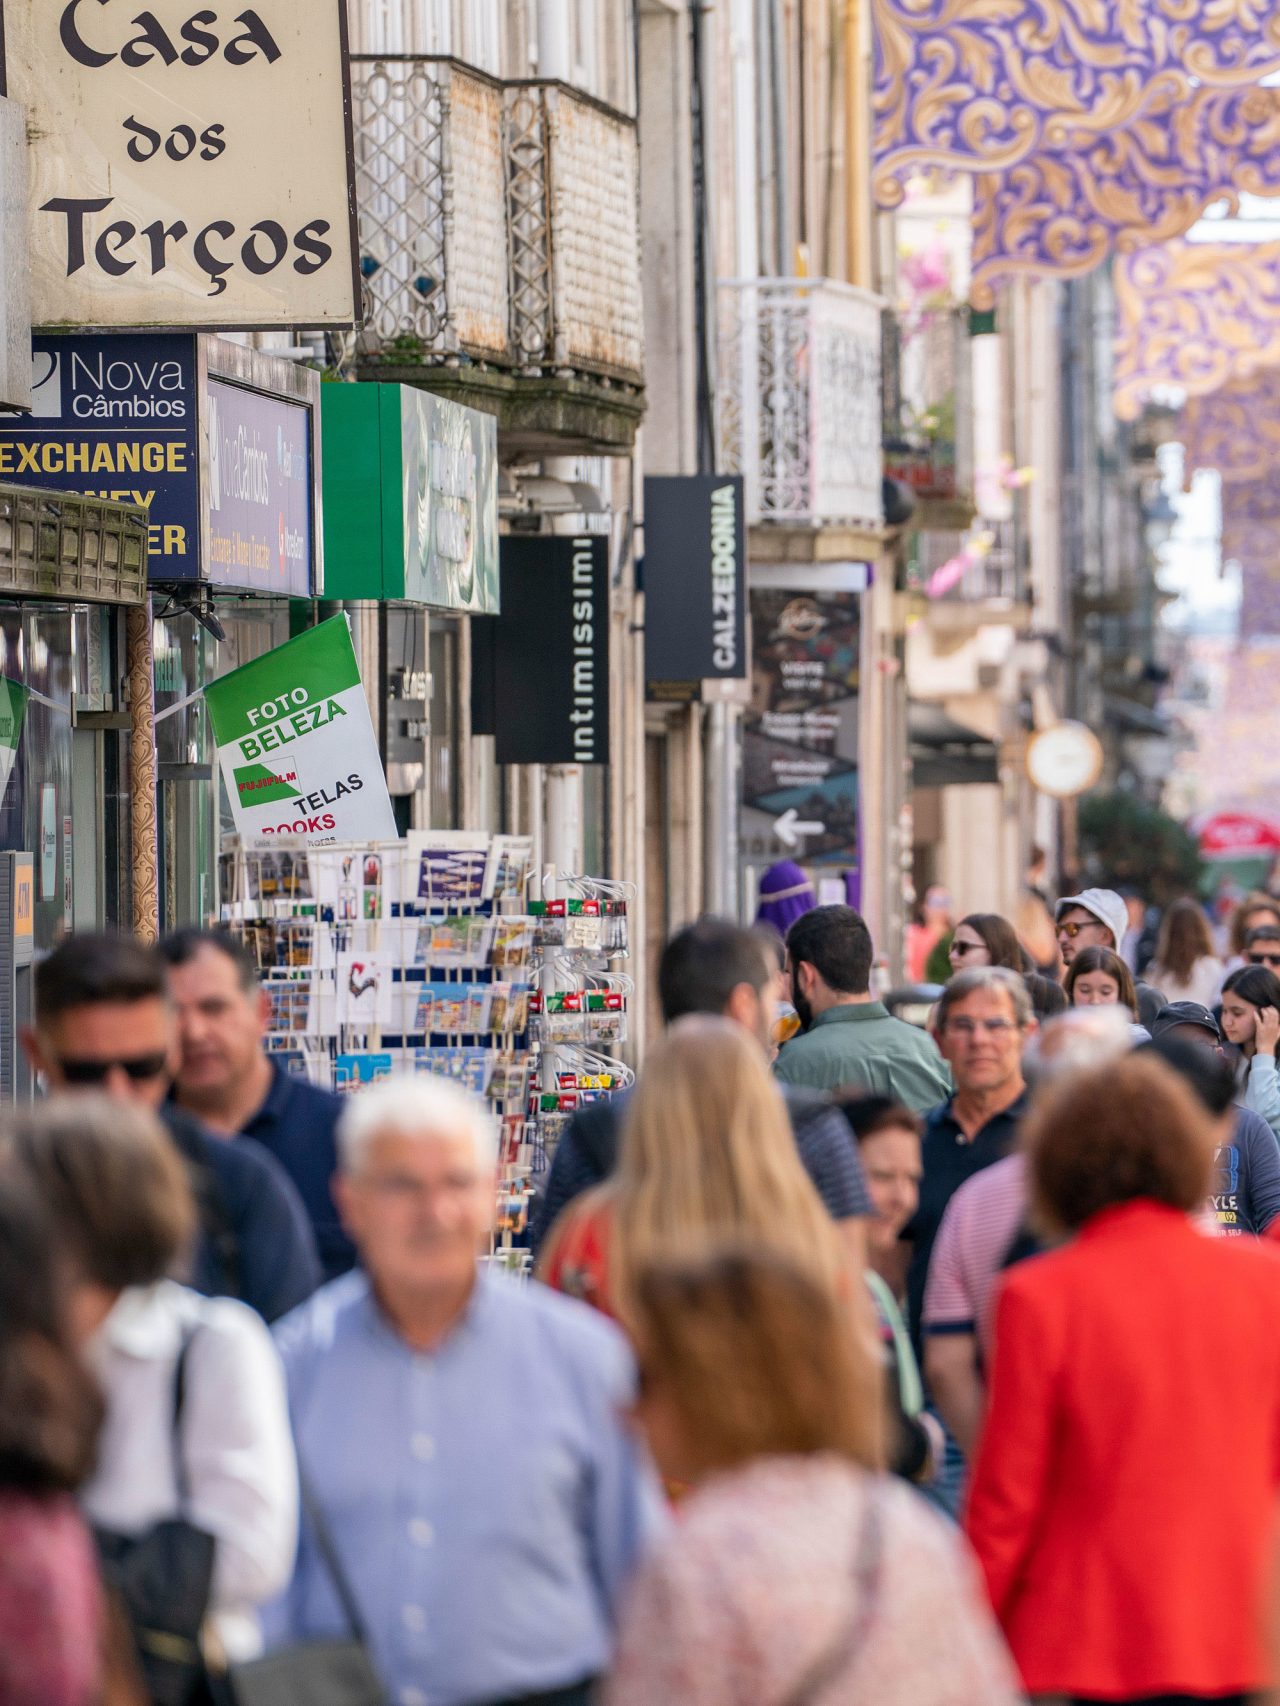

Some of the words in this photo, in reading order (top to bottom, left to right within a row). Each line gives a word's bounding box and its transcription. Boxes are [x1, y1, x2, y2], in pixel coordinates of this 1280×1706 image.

[59, 0, 283, 68] Casa
[122, 115, 227, 163] dos
[38, 197, 333, 297] Terços
[71, 351, 186, 391] Nova
[72, 393, 186, 418] Câmbios
[0, 442, 187, 473] EXCHANGE
[710, 484, 737, 671] CALZEDONIA
[246, 687, 309, 727] FOTO
[238, 698, 348, 762] BELEZA
[238, 771, 297, 793] FUJIFILM
[292, 773, 364, 816] TELAS
